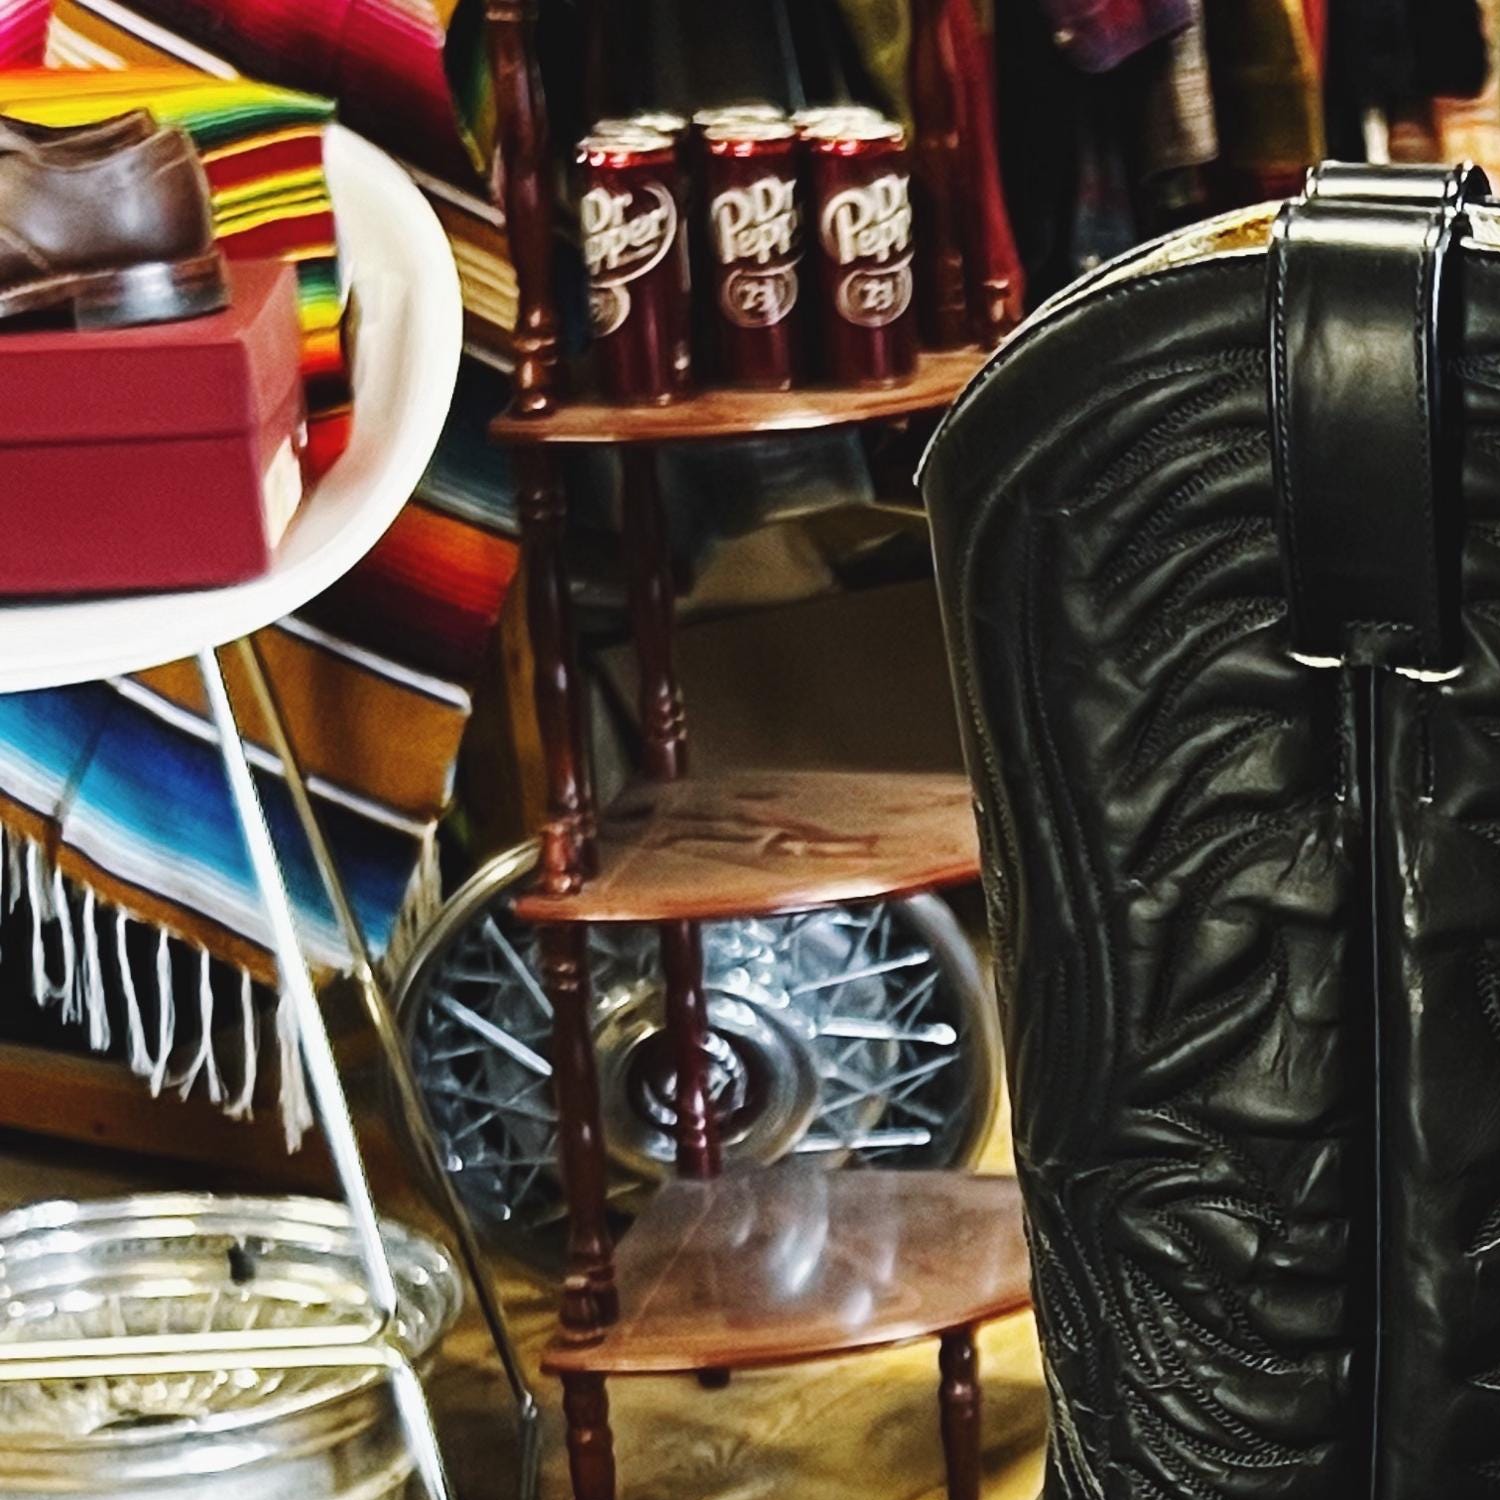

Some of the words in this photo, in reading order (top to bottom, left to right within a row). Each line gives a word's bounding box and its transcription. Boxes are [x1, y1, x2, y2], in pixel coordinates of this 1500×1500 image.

[581, 187, 633, 235] Dr
[584, 207, 668, 276] pper
[711, 188, 797, 265] Pepp
[821, 188, 912, 265] Pepp
